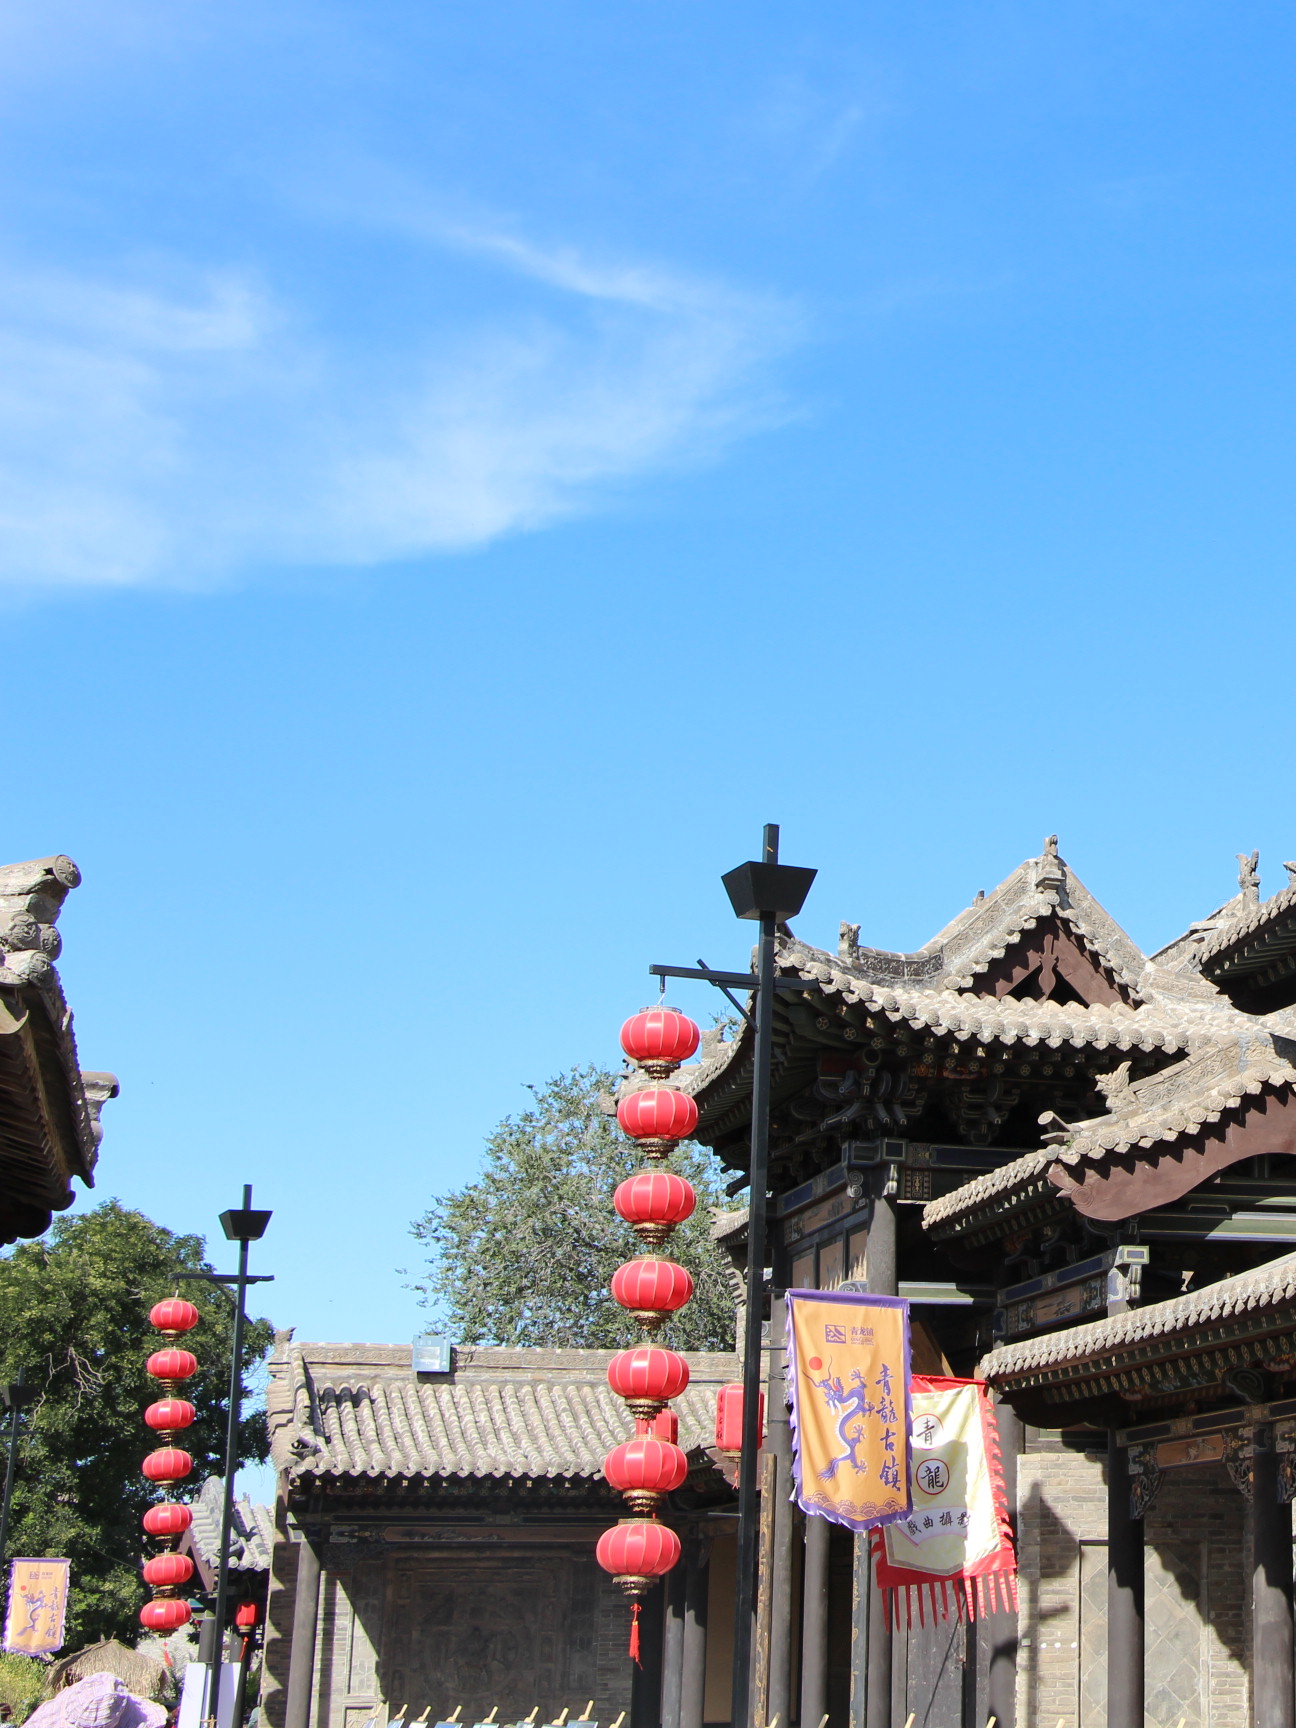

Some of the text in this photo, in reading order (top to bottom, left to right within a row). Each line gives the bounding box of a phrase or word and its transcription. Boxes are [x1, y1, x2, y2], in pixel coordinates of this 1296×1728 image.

[850, 1326, 874, 1336] 青龙镇
[916, 1418, 944, 1489] 青龍
